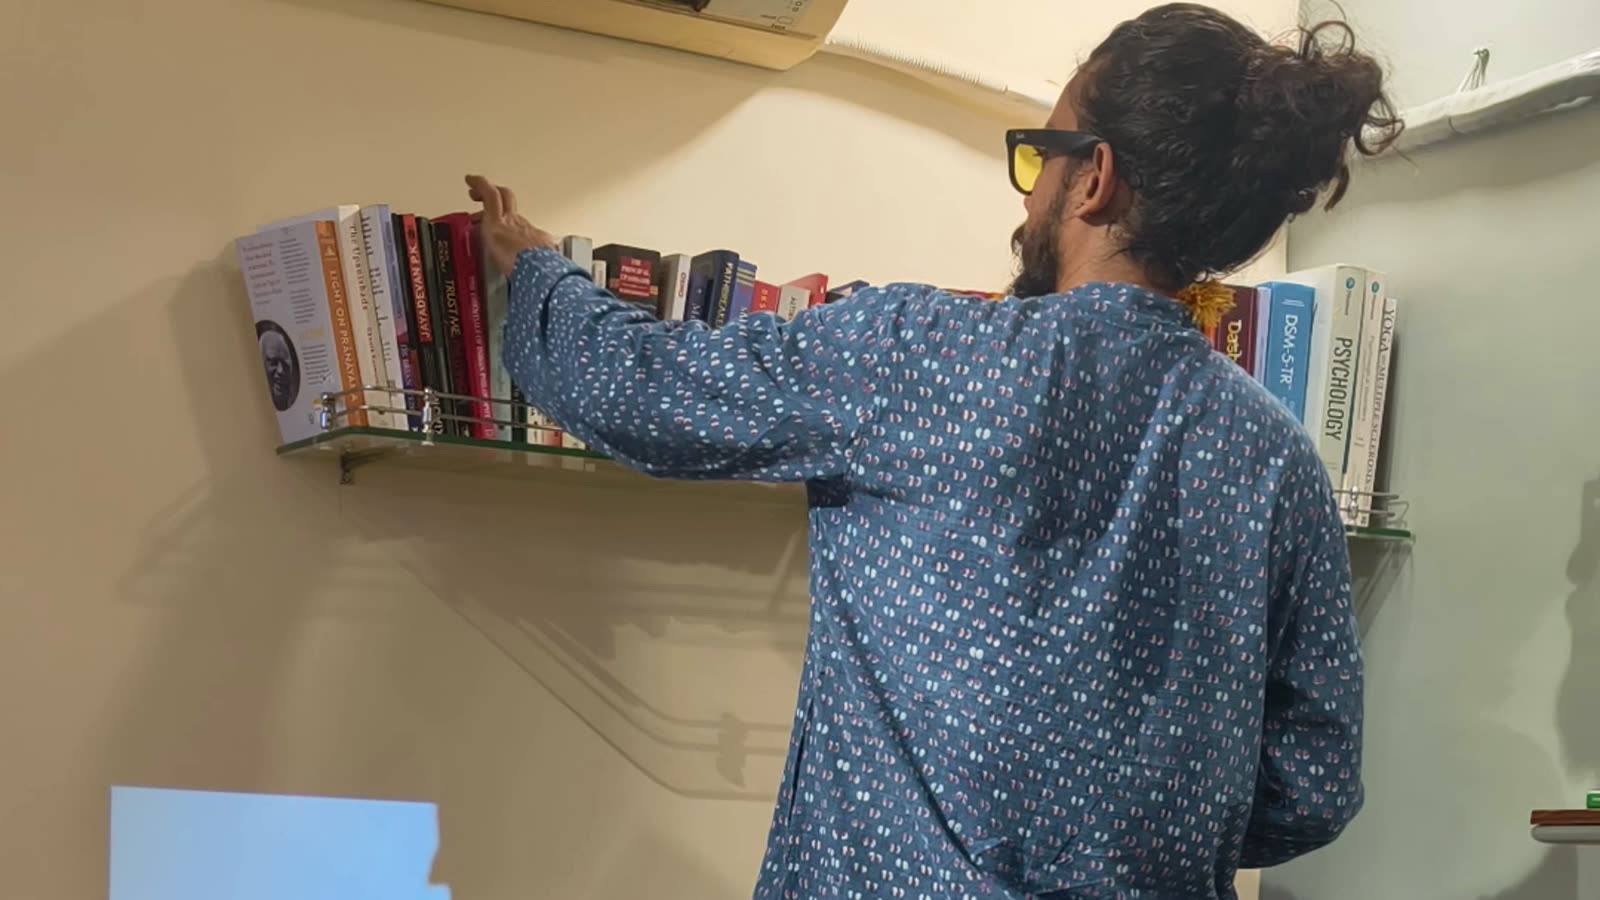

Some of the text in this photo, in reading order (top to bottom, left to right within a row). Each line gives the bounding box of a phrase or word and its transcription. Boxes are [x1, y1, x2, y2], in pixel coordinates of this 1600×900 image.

[329, 270, 343, 305] LIGHT
[411, 267, 431, 339] JAYADEVAN
[444, 279, 458, 317] TRUST
[335, 307, 347, 327] ON
[449, 317, 461, 337] ME
[1379, 308, 1395, 352] YOGA
[1280, 313, 1299, 385] DSM-5-TR
[1324, 336, 1354, 441] PSYCHOLOGY
[1372, 364, 1387, 421] MULTIPLE
